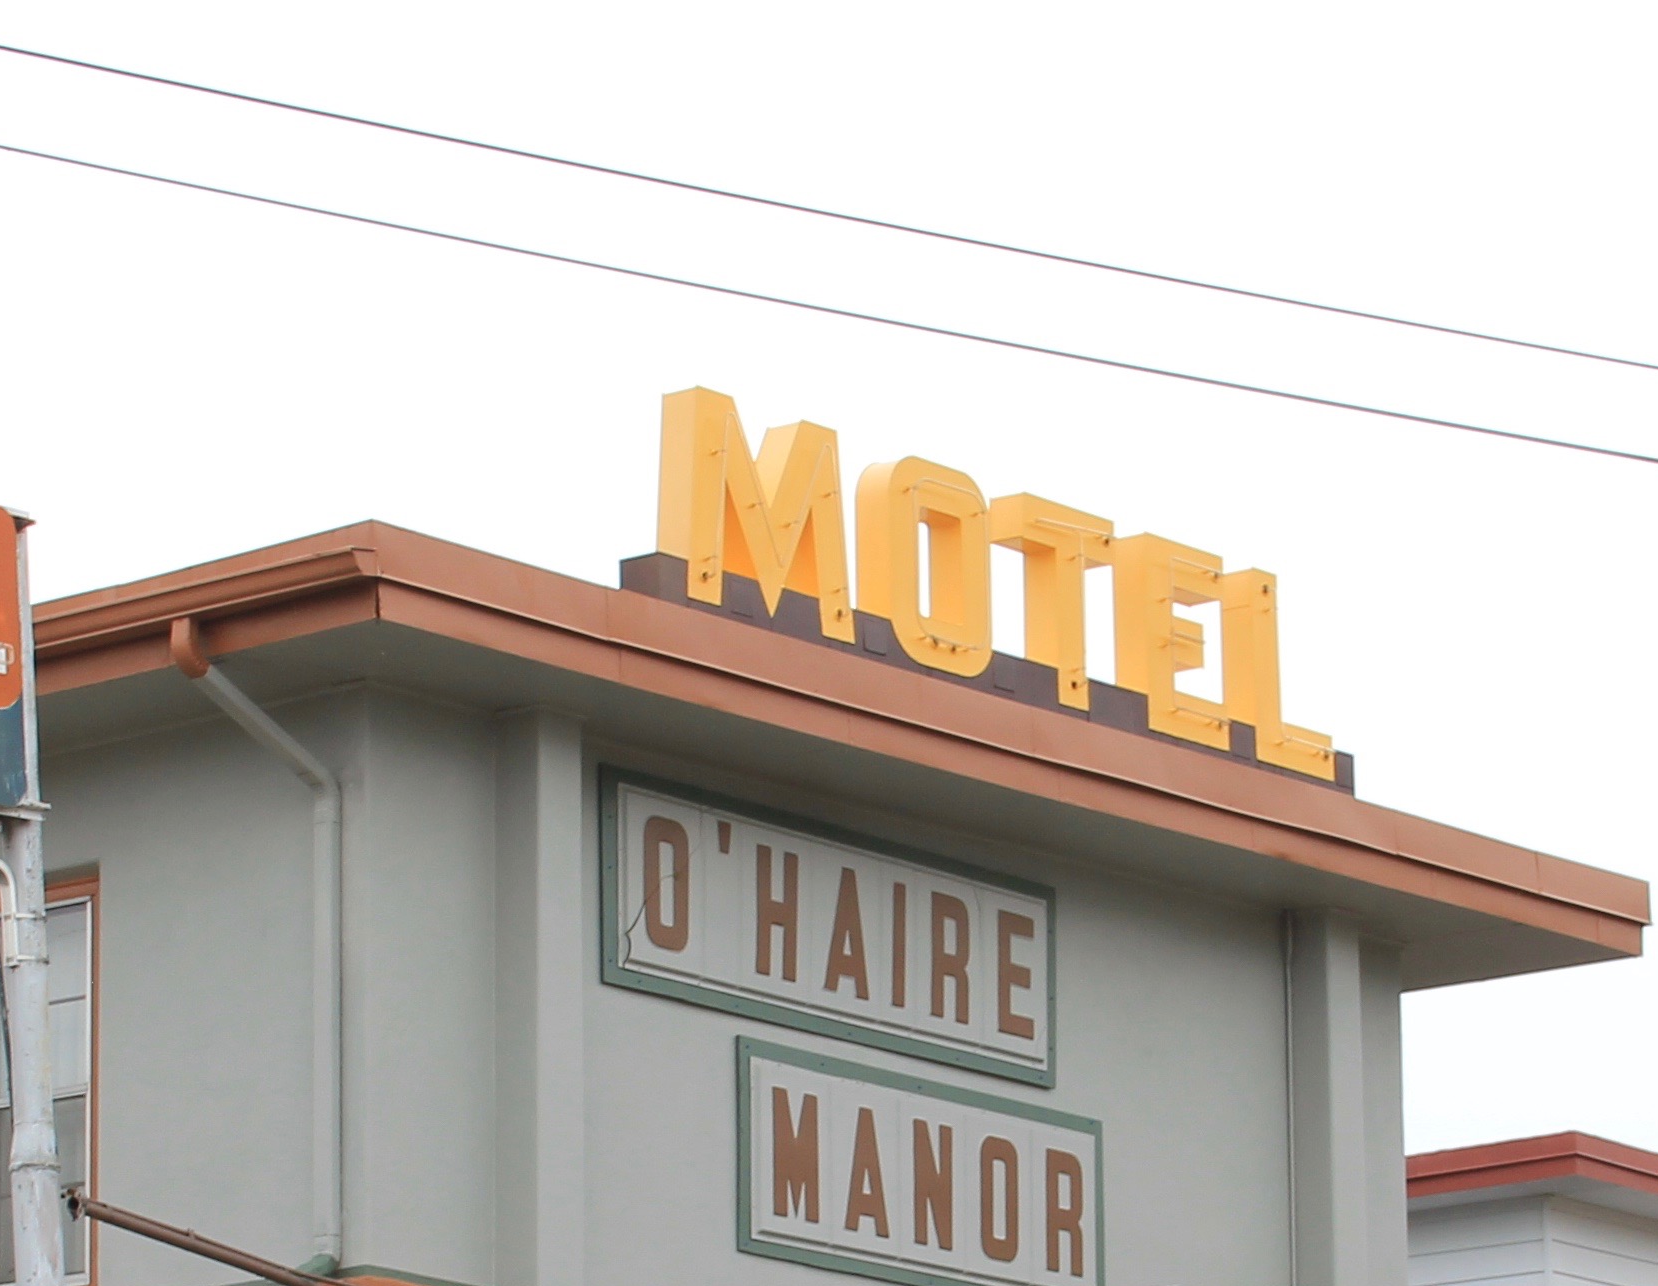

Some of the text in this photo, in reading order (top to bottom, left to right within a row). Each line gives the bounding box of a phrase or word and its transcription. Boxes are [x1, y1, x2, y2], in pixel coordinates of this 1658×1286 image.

[657, 386, 1336, 783] MOTEL
[642, 815, 1036, 1040] O'HAIRE
[771, 1086, 1085, 1278] MANOR
